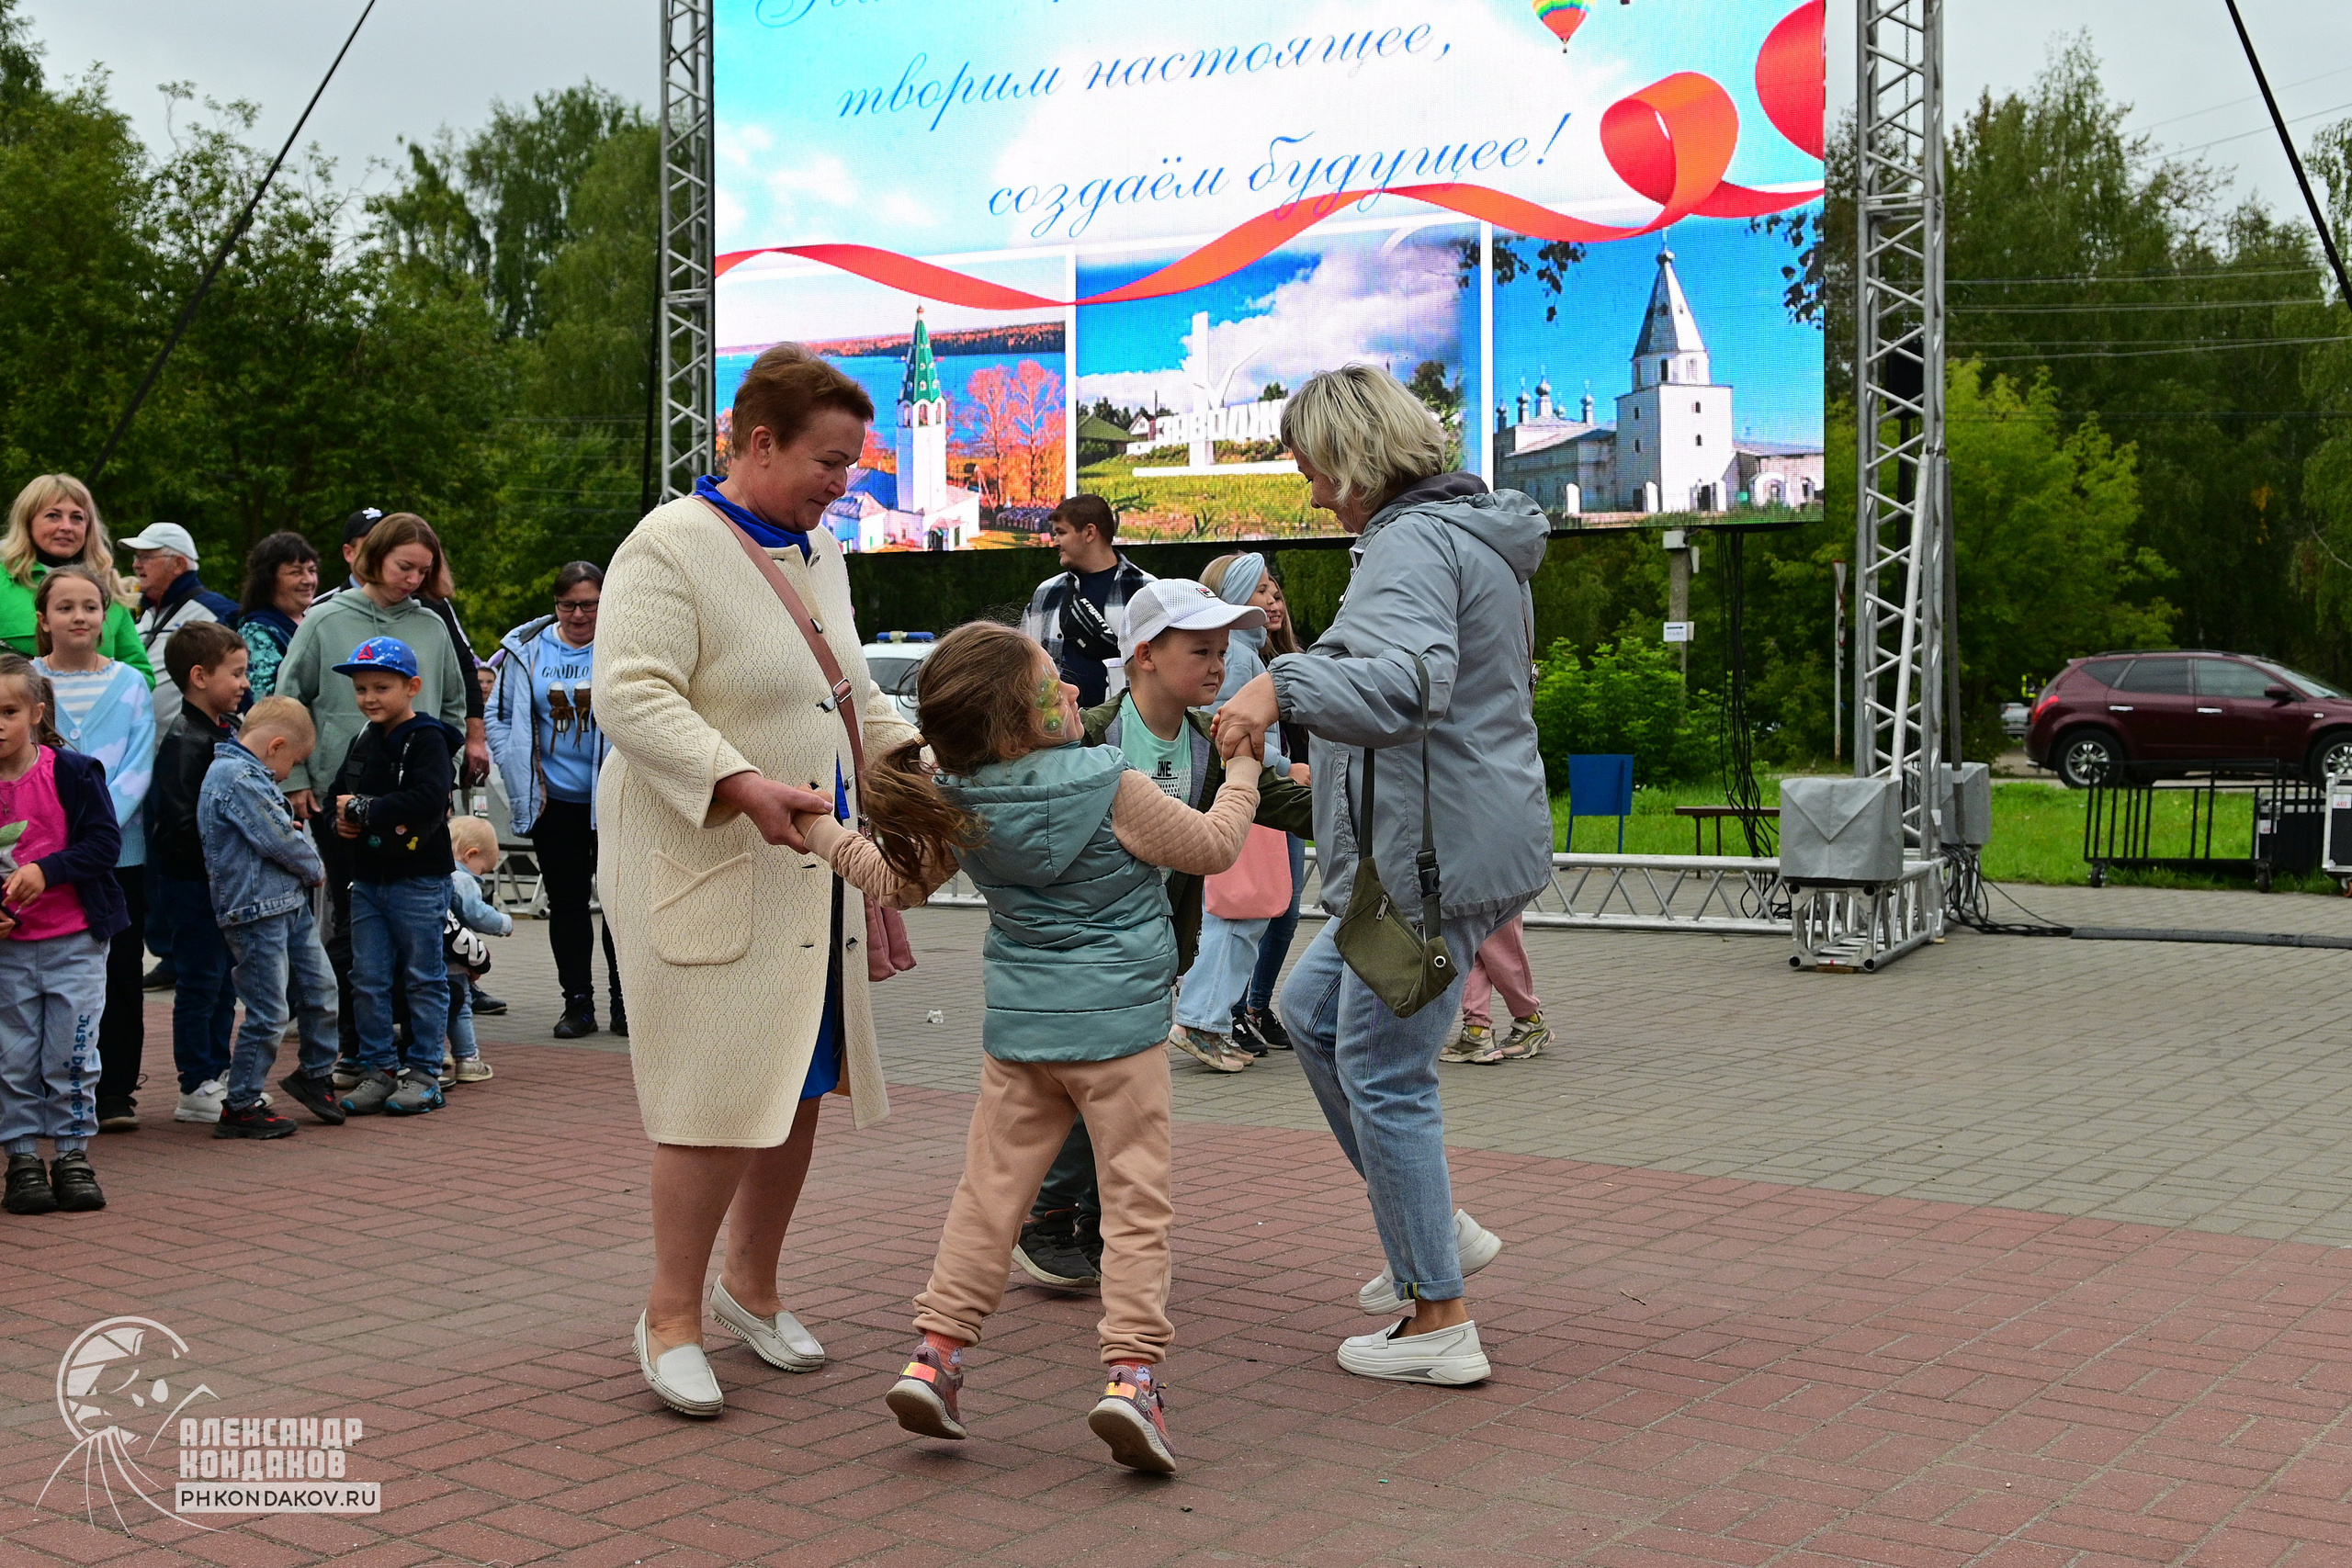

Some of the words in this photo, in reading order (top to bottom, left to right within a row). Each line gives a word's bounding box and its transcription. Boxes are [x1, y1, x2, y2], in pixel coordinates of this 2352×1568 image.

[835, 52, 1064, 131] творим
[1083, 23, 1451, 92] настоящее,
[989, 155, 1230, 238] создаём
[1249, 112, 1571, 220] будущее!
[73, 1014, 91, 1052] Just
